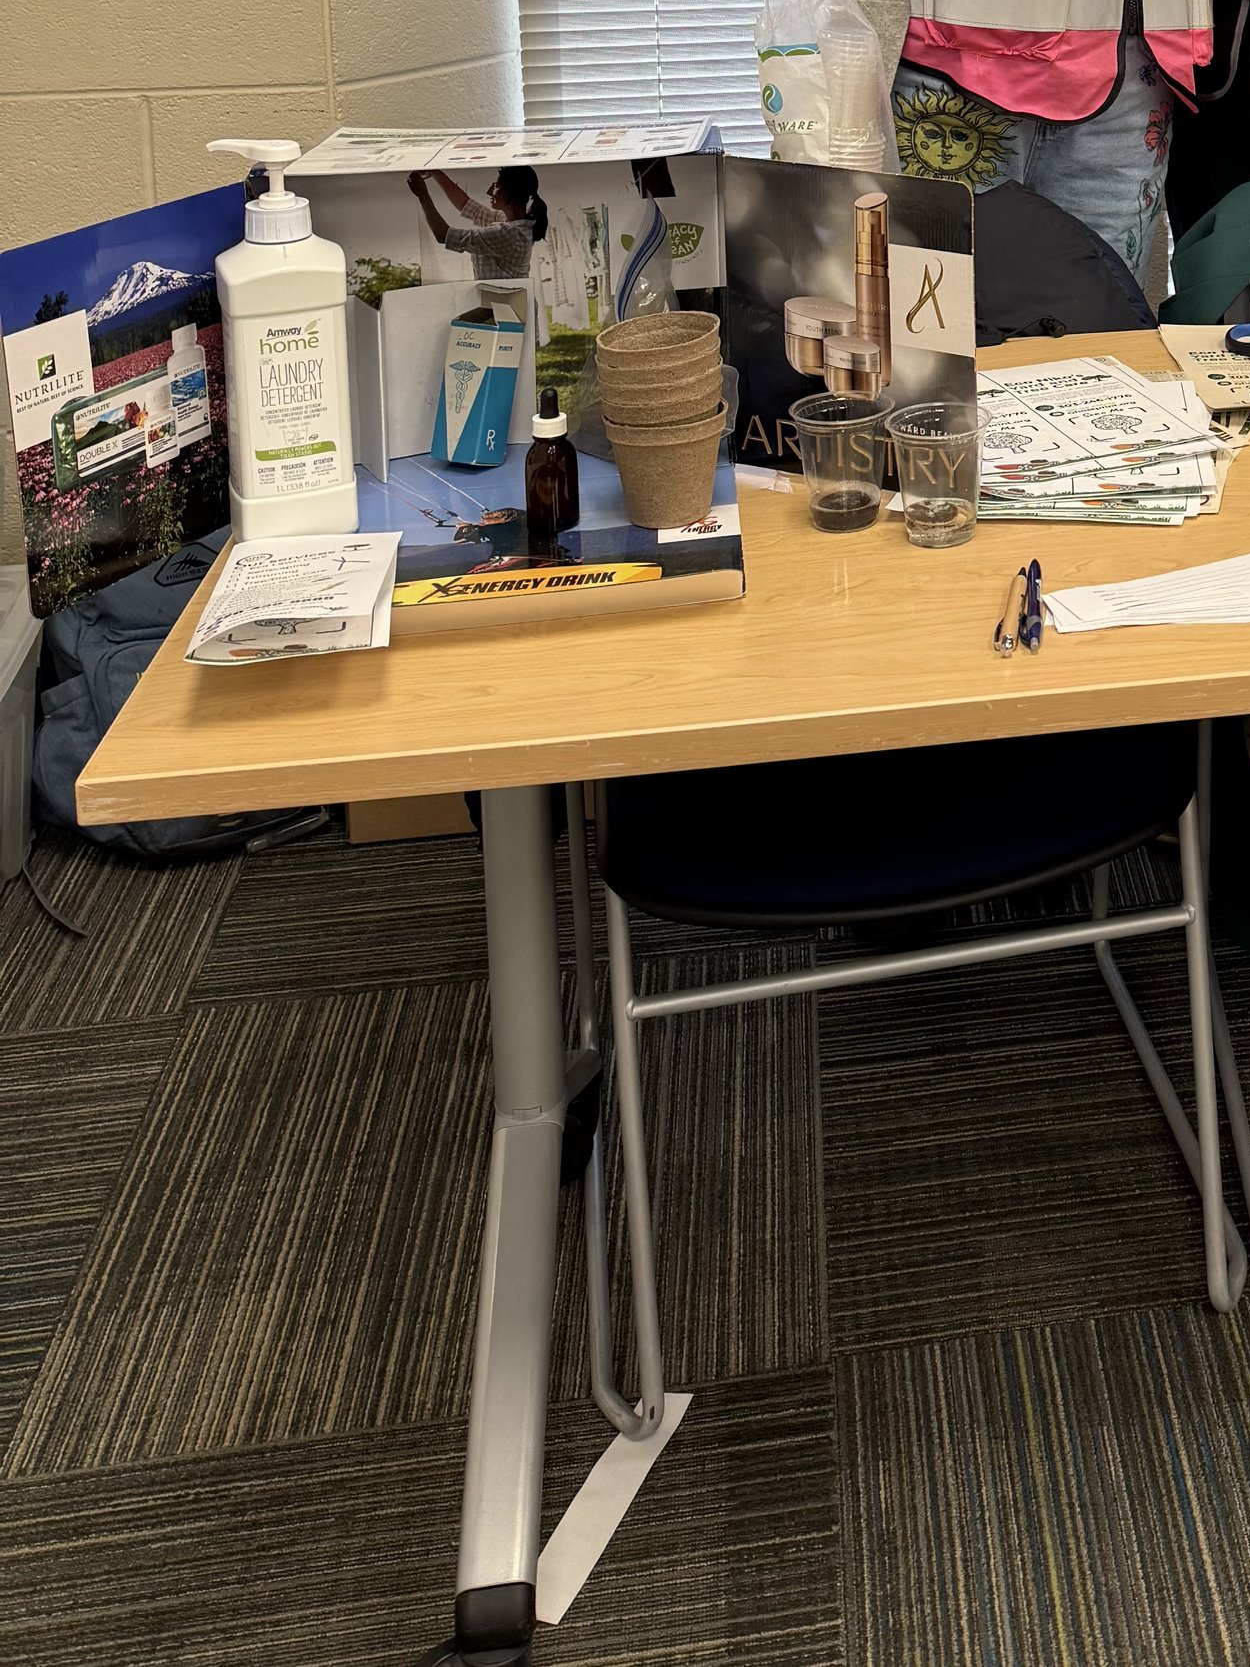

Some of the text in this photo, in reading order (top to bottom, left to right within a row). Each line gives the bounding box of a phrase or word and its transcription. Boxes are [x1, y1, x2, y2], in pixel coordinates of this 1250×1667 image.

[266, 327, 302, 338] Amway
[260, 336, 319, 355] home
[456, 341, 481, 349] ACCURACY
[259, 358, 323, 389] LAUNDRY
[14, 370, 85, 405] NUTRILITE
[261, 382, 323, 408] DETERGENT
[79, 443, 111, 463] DOUBLE
[112, 440, 119, 452] X
[742, 415, 966, 488] ARTISTRY
[463, 577, 547, 595] ENERGY
[546, 571, 617, 588] DRINK
